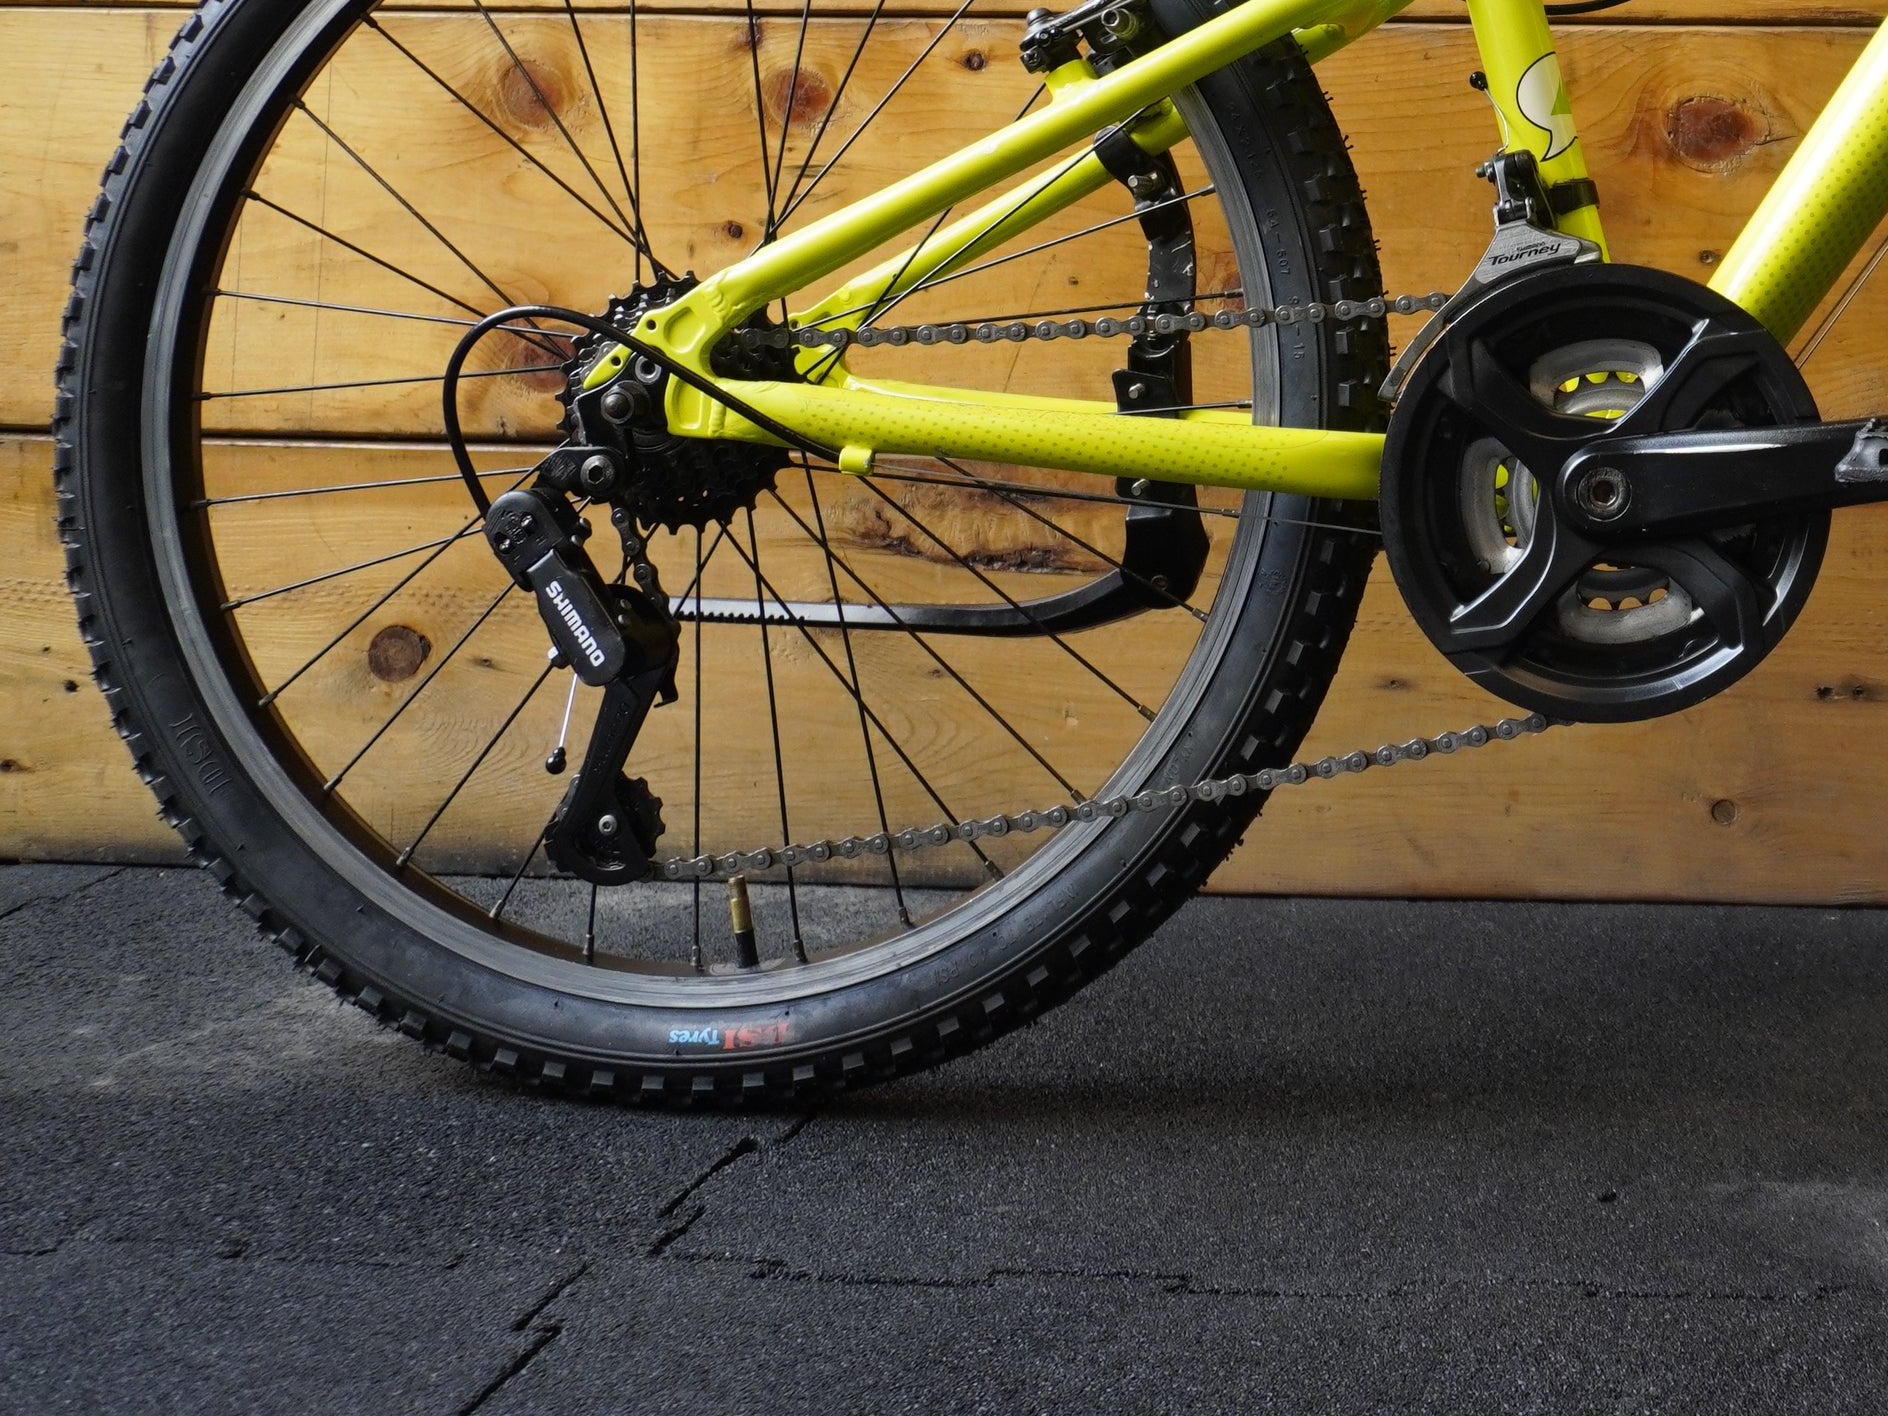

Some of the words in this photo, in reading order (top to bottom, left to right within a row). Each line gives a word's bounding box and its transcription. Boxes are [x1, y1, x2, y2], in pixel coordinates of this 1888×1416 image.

[1489, 242, 1561, 266] Tourney
[545, 580, 606, 667] SHIMANO
[668, 1027, 720, 1045] Tyres
